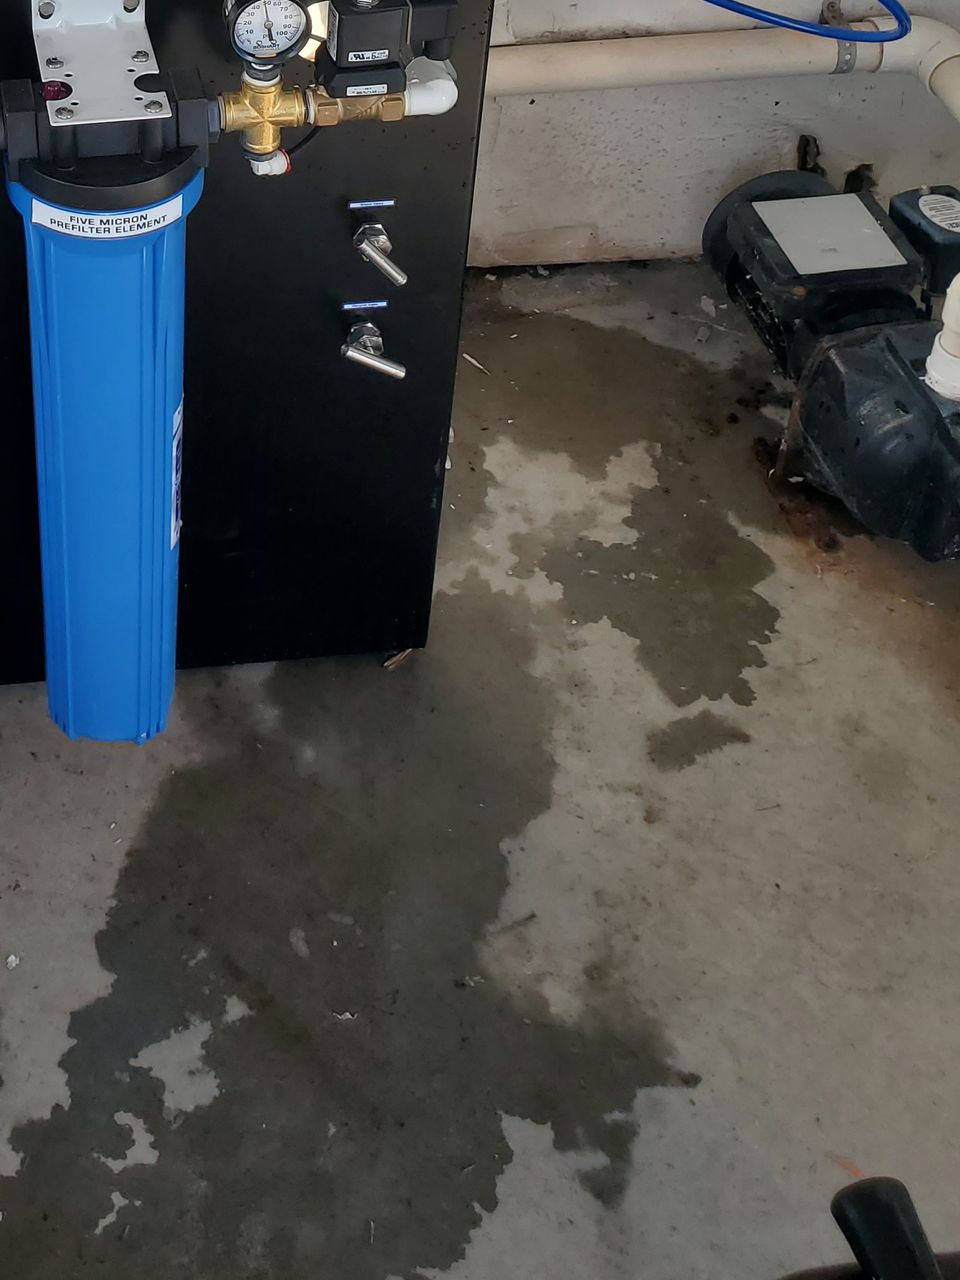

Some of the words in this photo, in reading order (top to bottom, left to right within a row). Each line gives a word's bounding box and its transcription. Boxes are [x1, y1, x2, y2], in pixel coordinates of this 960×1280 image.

[50, 218, 111, 234] PREFILTER
[115, 214, 168, 234] ELEMENT
[69, 215, 95, 225] FIVE
[99, 213, 148, 225] MICRON
